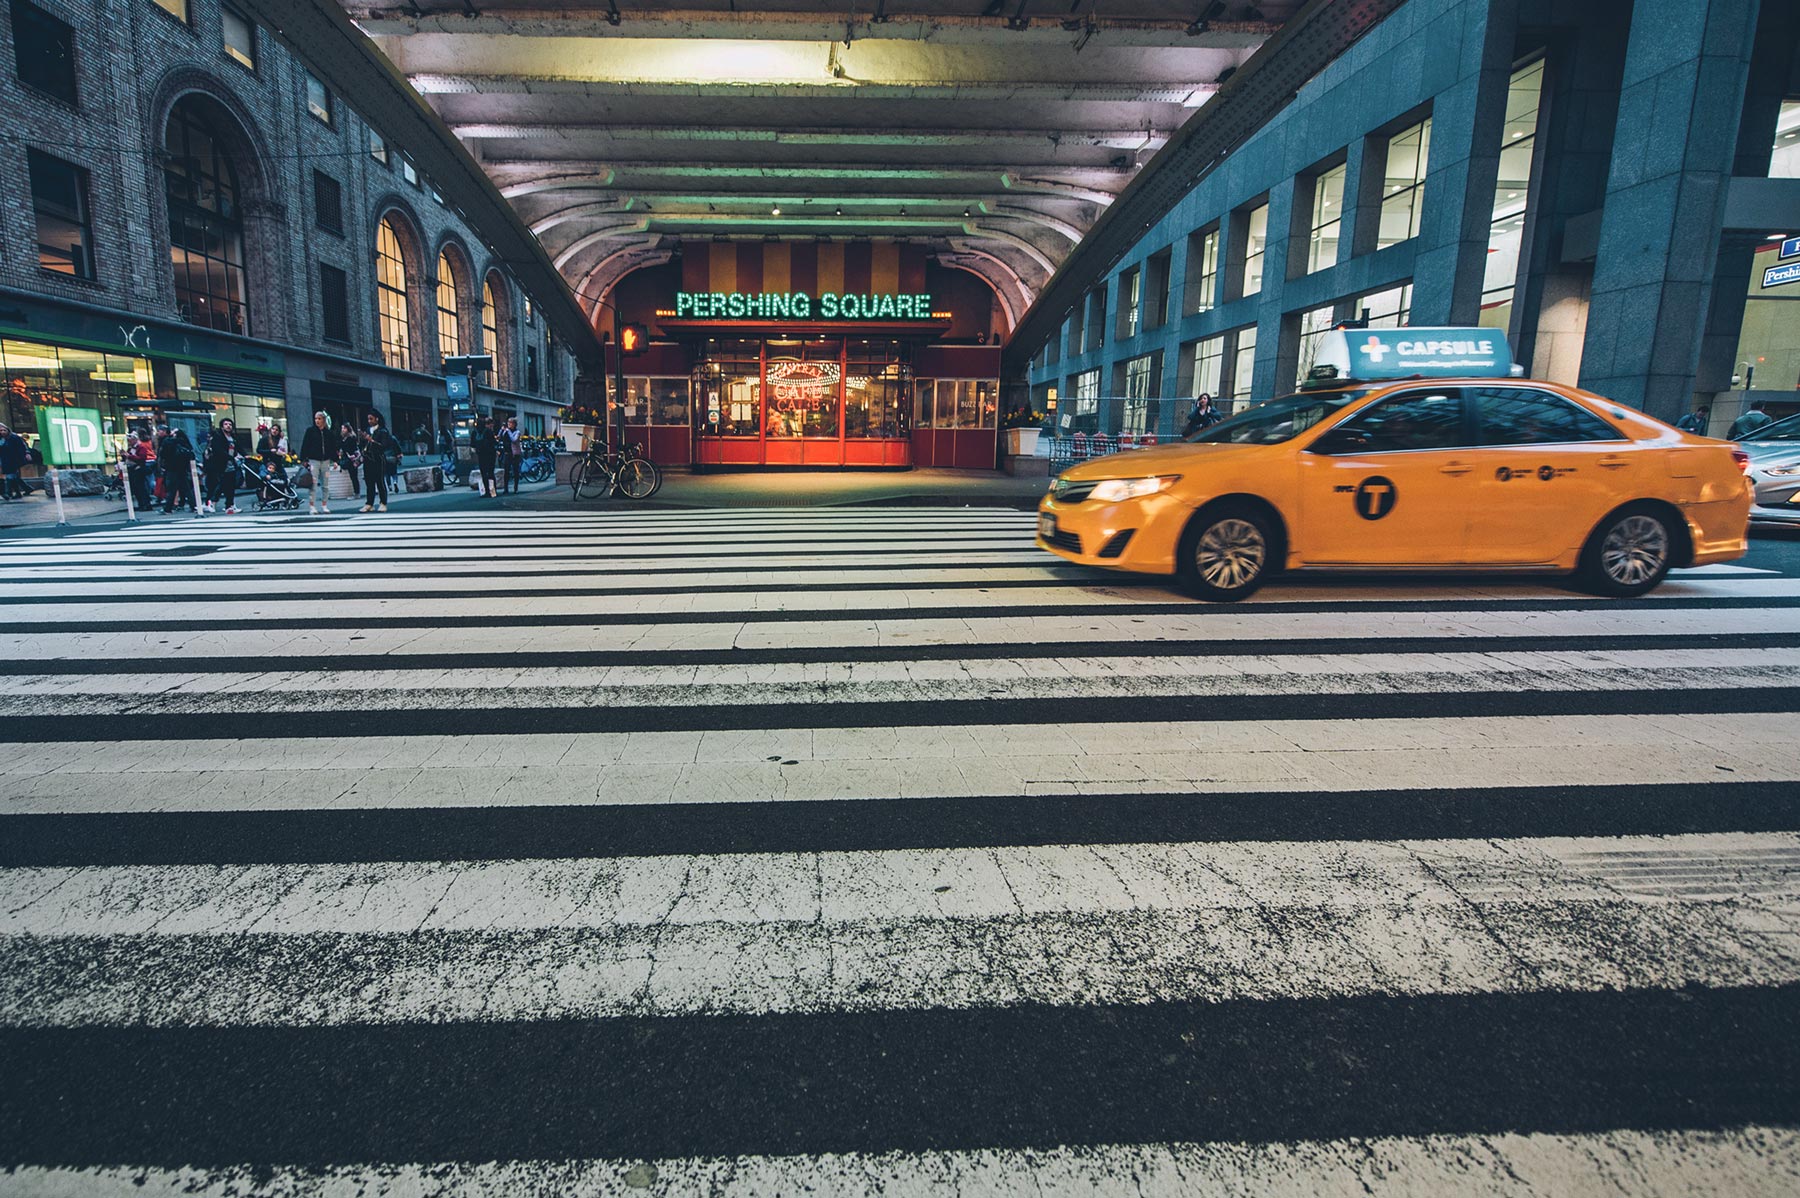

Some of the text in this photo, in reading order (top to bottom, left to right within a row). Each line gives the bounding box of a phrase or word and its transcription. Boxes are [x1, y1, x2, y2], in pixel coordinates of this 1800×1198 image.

[676, 292, 931, 318] PERSHING SQUARE
[1397, 341, 1493, 356] CAPSULE
[710, 394, 717, 402] A
[960, 400, 976, 408] BUZZ
[51, 418, 98, 453] TD
[1363, 484, 1389, 514] T
